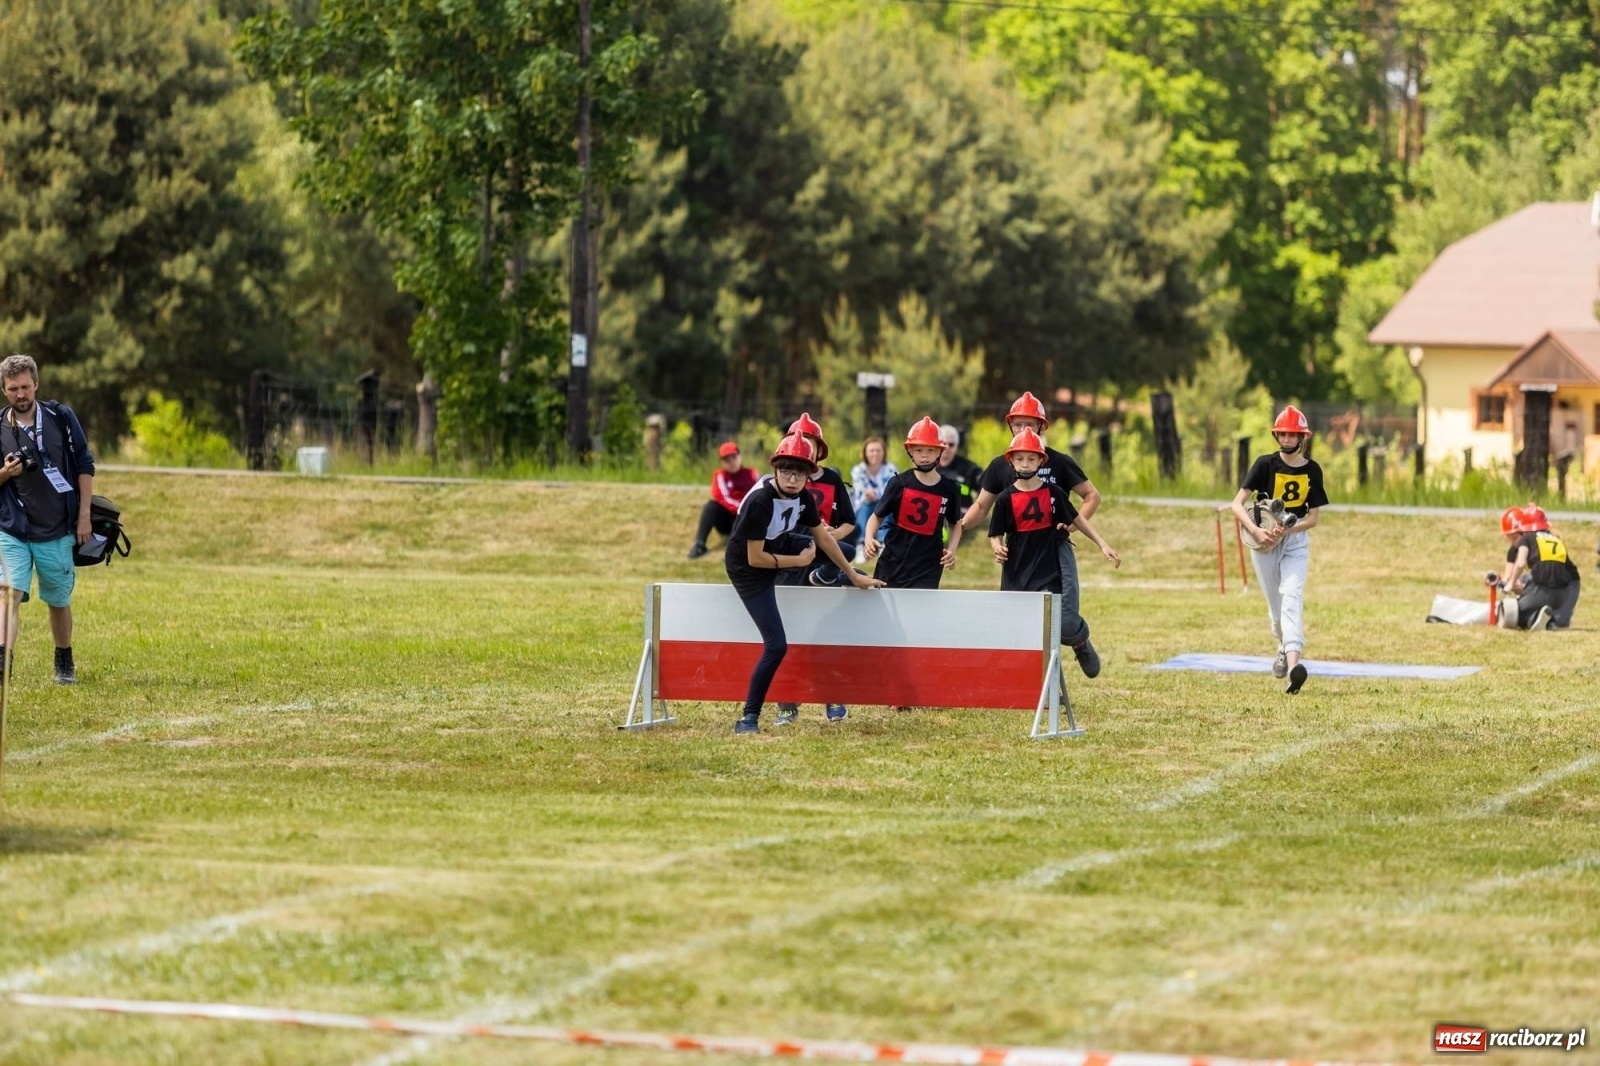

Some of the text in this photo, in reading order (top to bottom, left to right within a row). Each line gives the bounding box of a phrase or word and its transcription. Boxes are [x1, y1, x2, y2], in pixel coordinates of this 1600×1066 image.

[1281, 481, 1300, 502] 8
[780, 506, 794, 531] 1
[906, 497, 930, 526] 3
[1022, 497, 1044, 523] 4
[1545, 540, 1558, 555] 7
